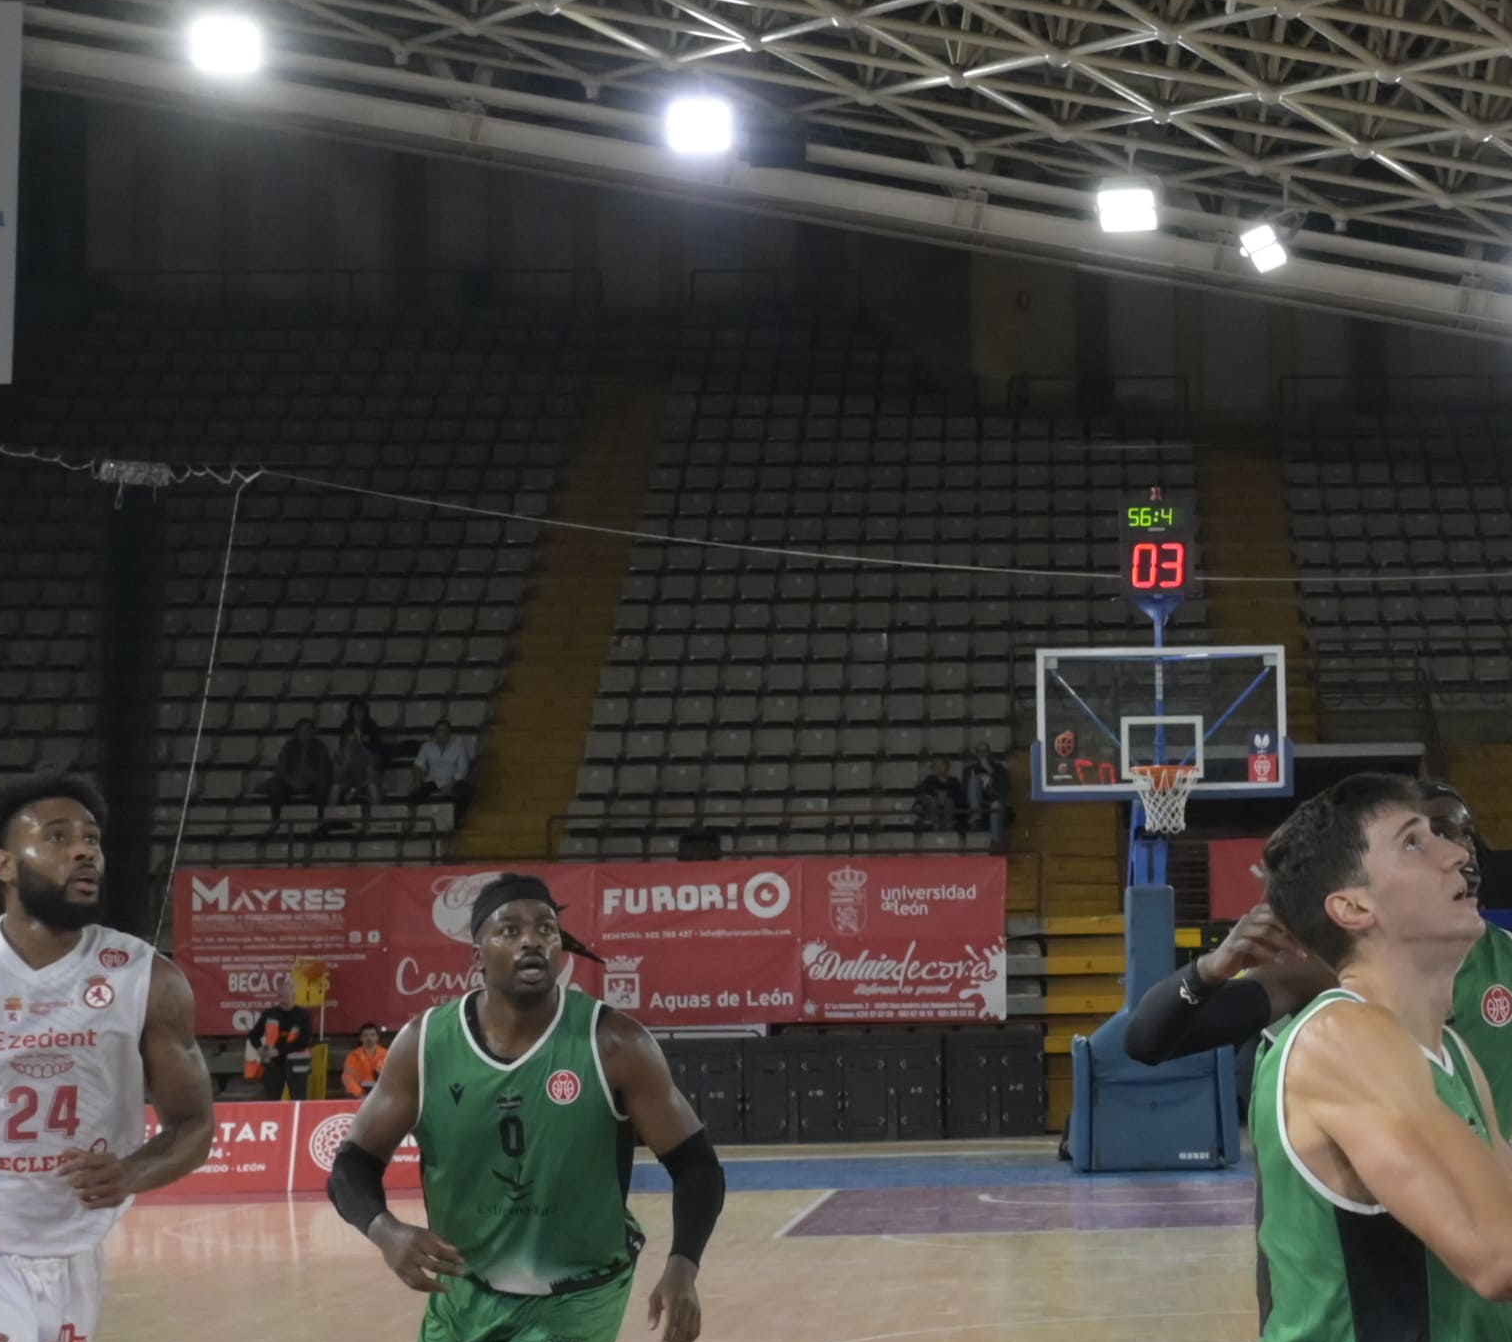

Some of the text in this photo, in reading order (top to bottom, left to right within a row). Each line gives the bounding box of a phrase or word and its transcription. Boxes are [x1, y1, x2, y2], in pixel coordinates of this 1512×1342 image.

[1127, 507, 1173, 527] 56:4
[1131, 542, 1185, 589] 03
[192, 876, 346, 911] MAYRES
[603, 883, 738, 915] FUROR!
[881, 884, 976, 900] universidad
[894, 901, 928, 915] león
[228, 972, 270, 992] BECA
[650, 988, 793, 1012] Aguas de León
[5, 1085, 81, 1141] 24
[499, 1116, 526, 1158] 0
